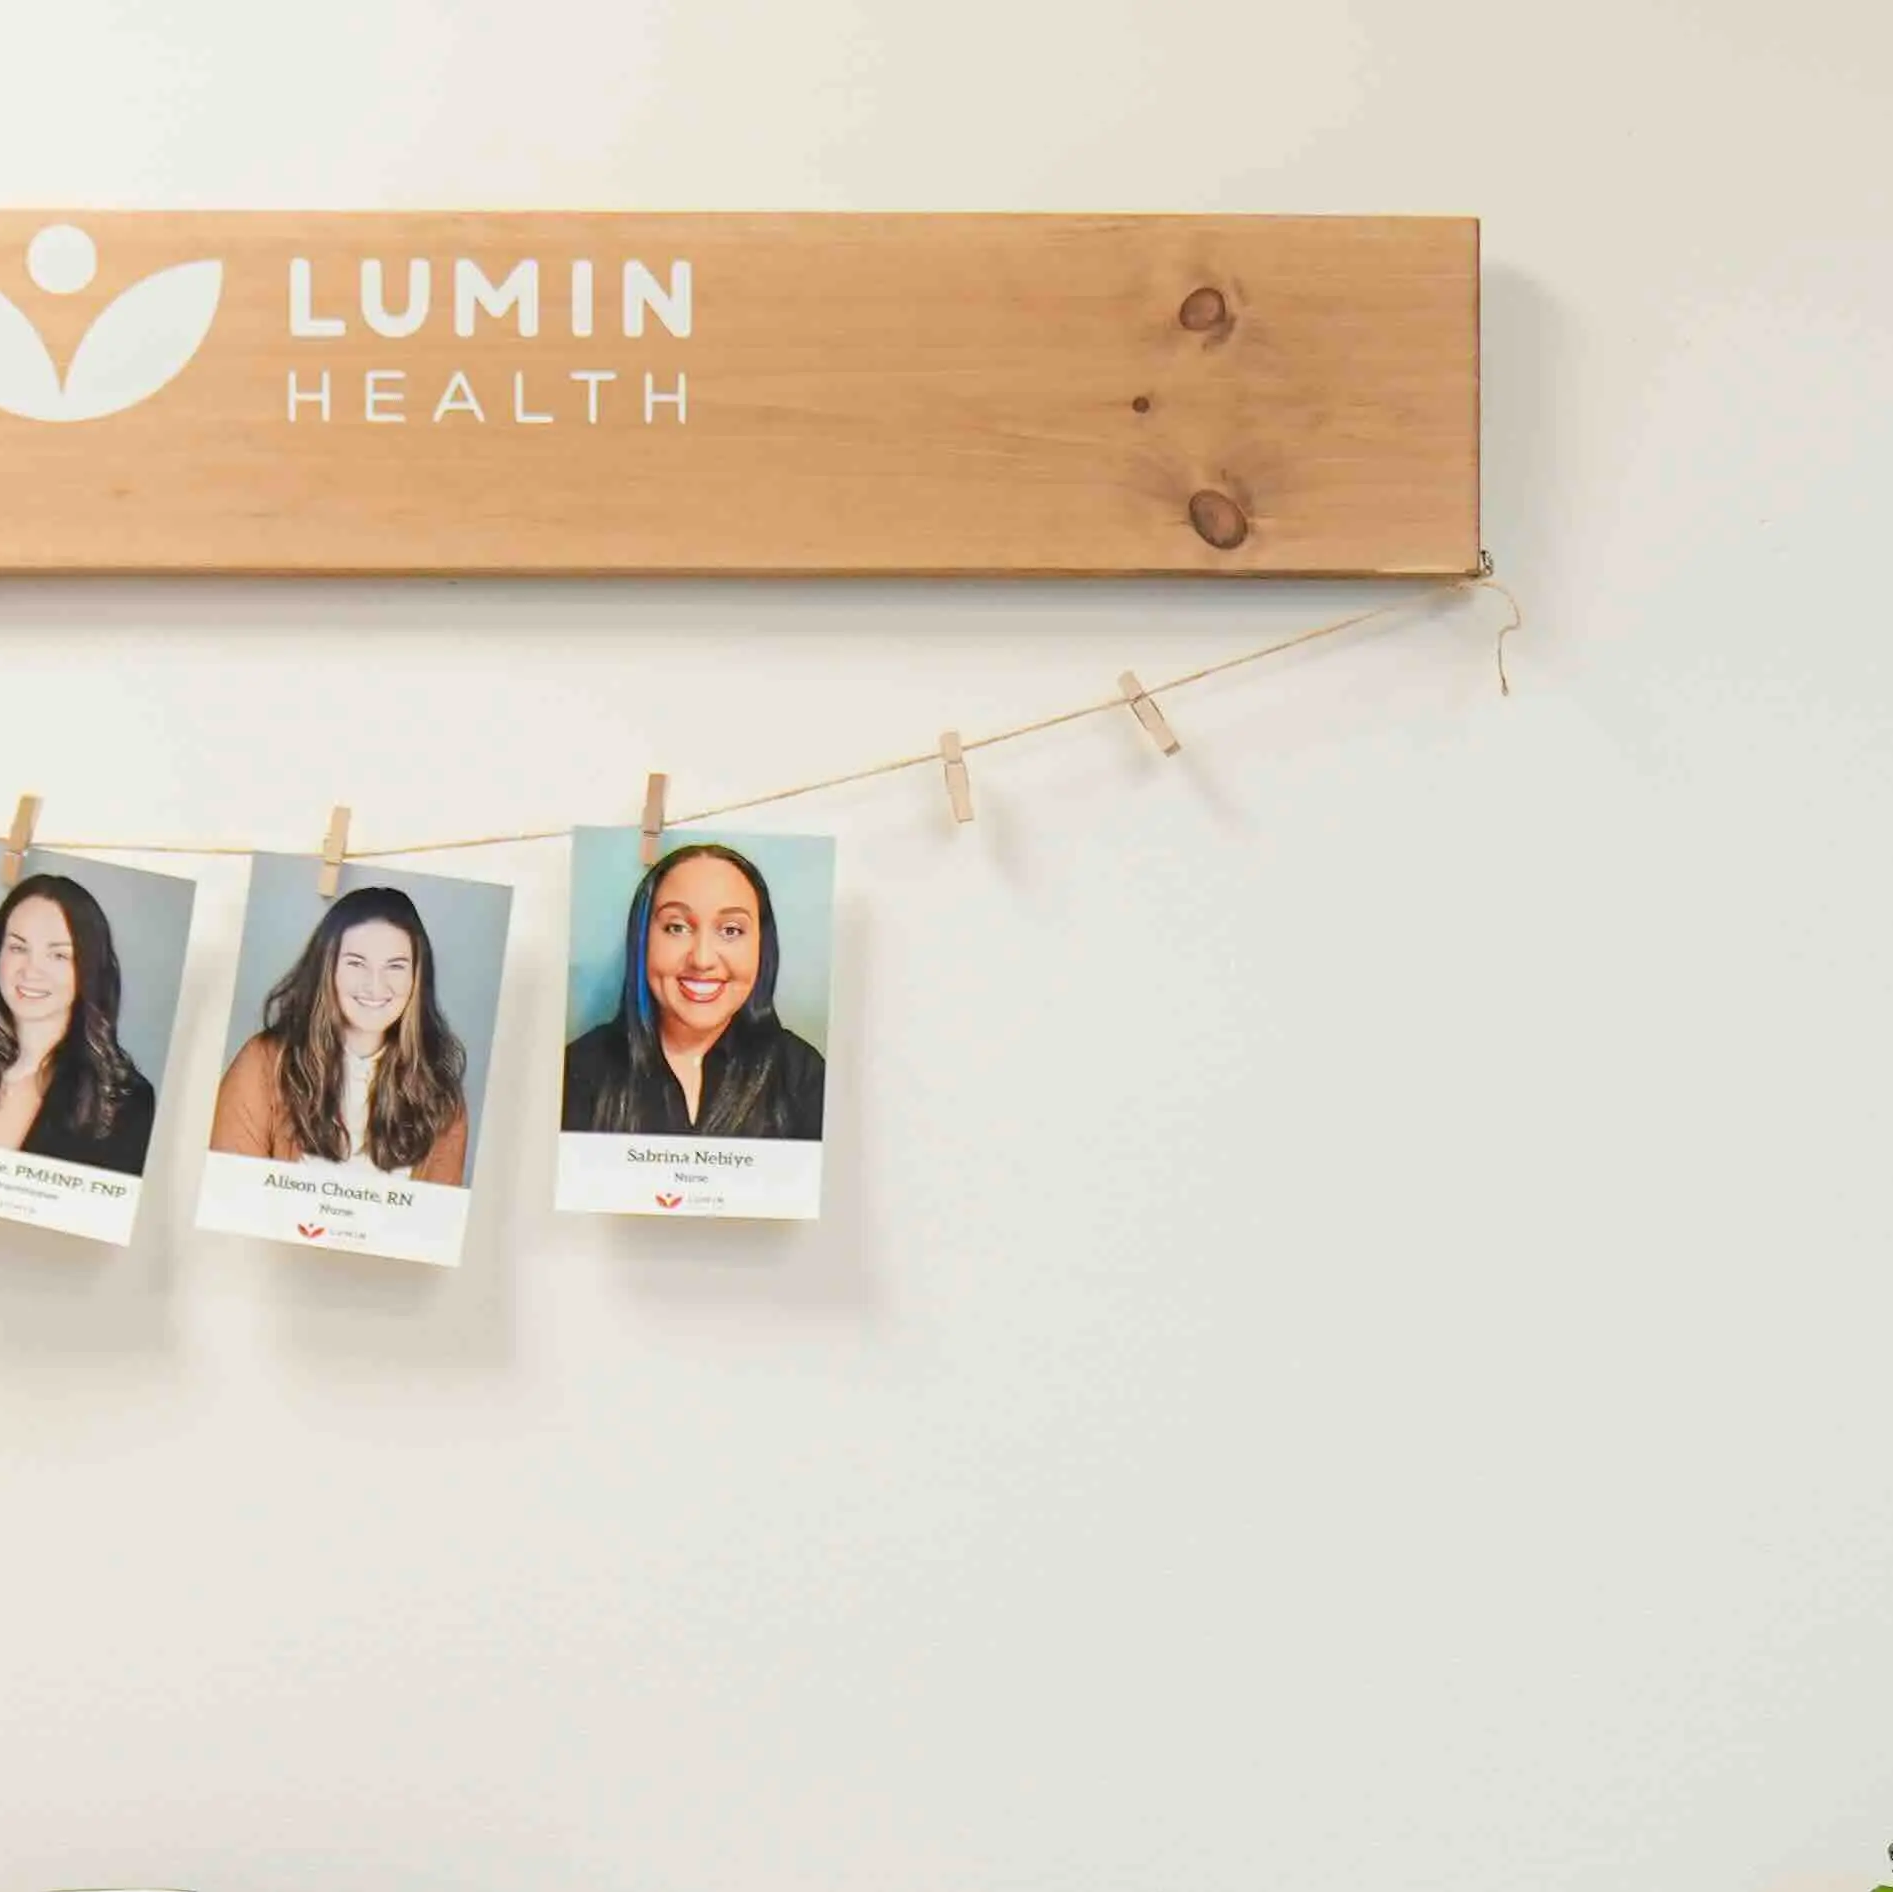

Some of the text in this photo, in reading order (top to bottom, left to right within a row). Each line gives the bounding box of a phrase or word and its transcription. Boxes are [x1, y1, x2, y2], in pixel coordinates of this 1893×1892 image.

[289, 257, 692, 337] LUMIN
[287, 369, 687, 424] HEALTH
[626, 1149, 755, 1168] Sabrina Nebiye
[15, 1162, 86, 1192] PMHNP,
[90, 1180, 127, 1199] FNP
[263, 1172, 414, 1207] Alison Choate, RN
[674, 1172, 709, 1184] Nurse
[318, 1203, 355, 1218] Nurse
